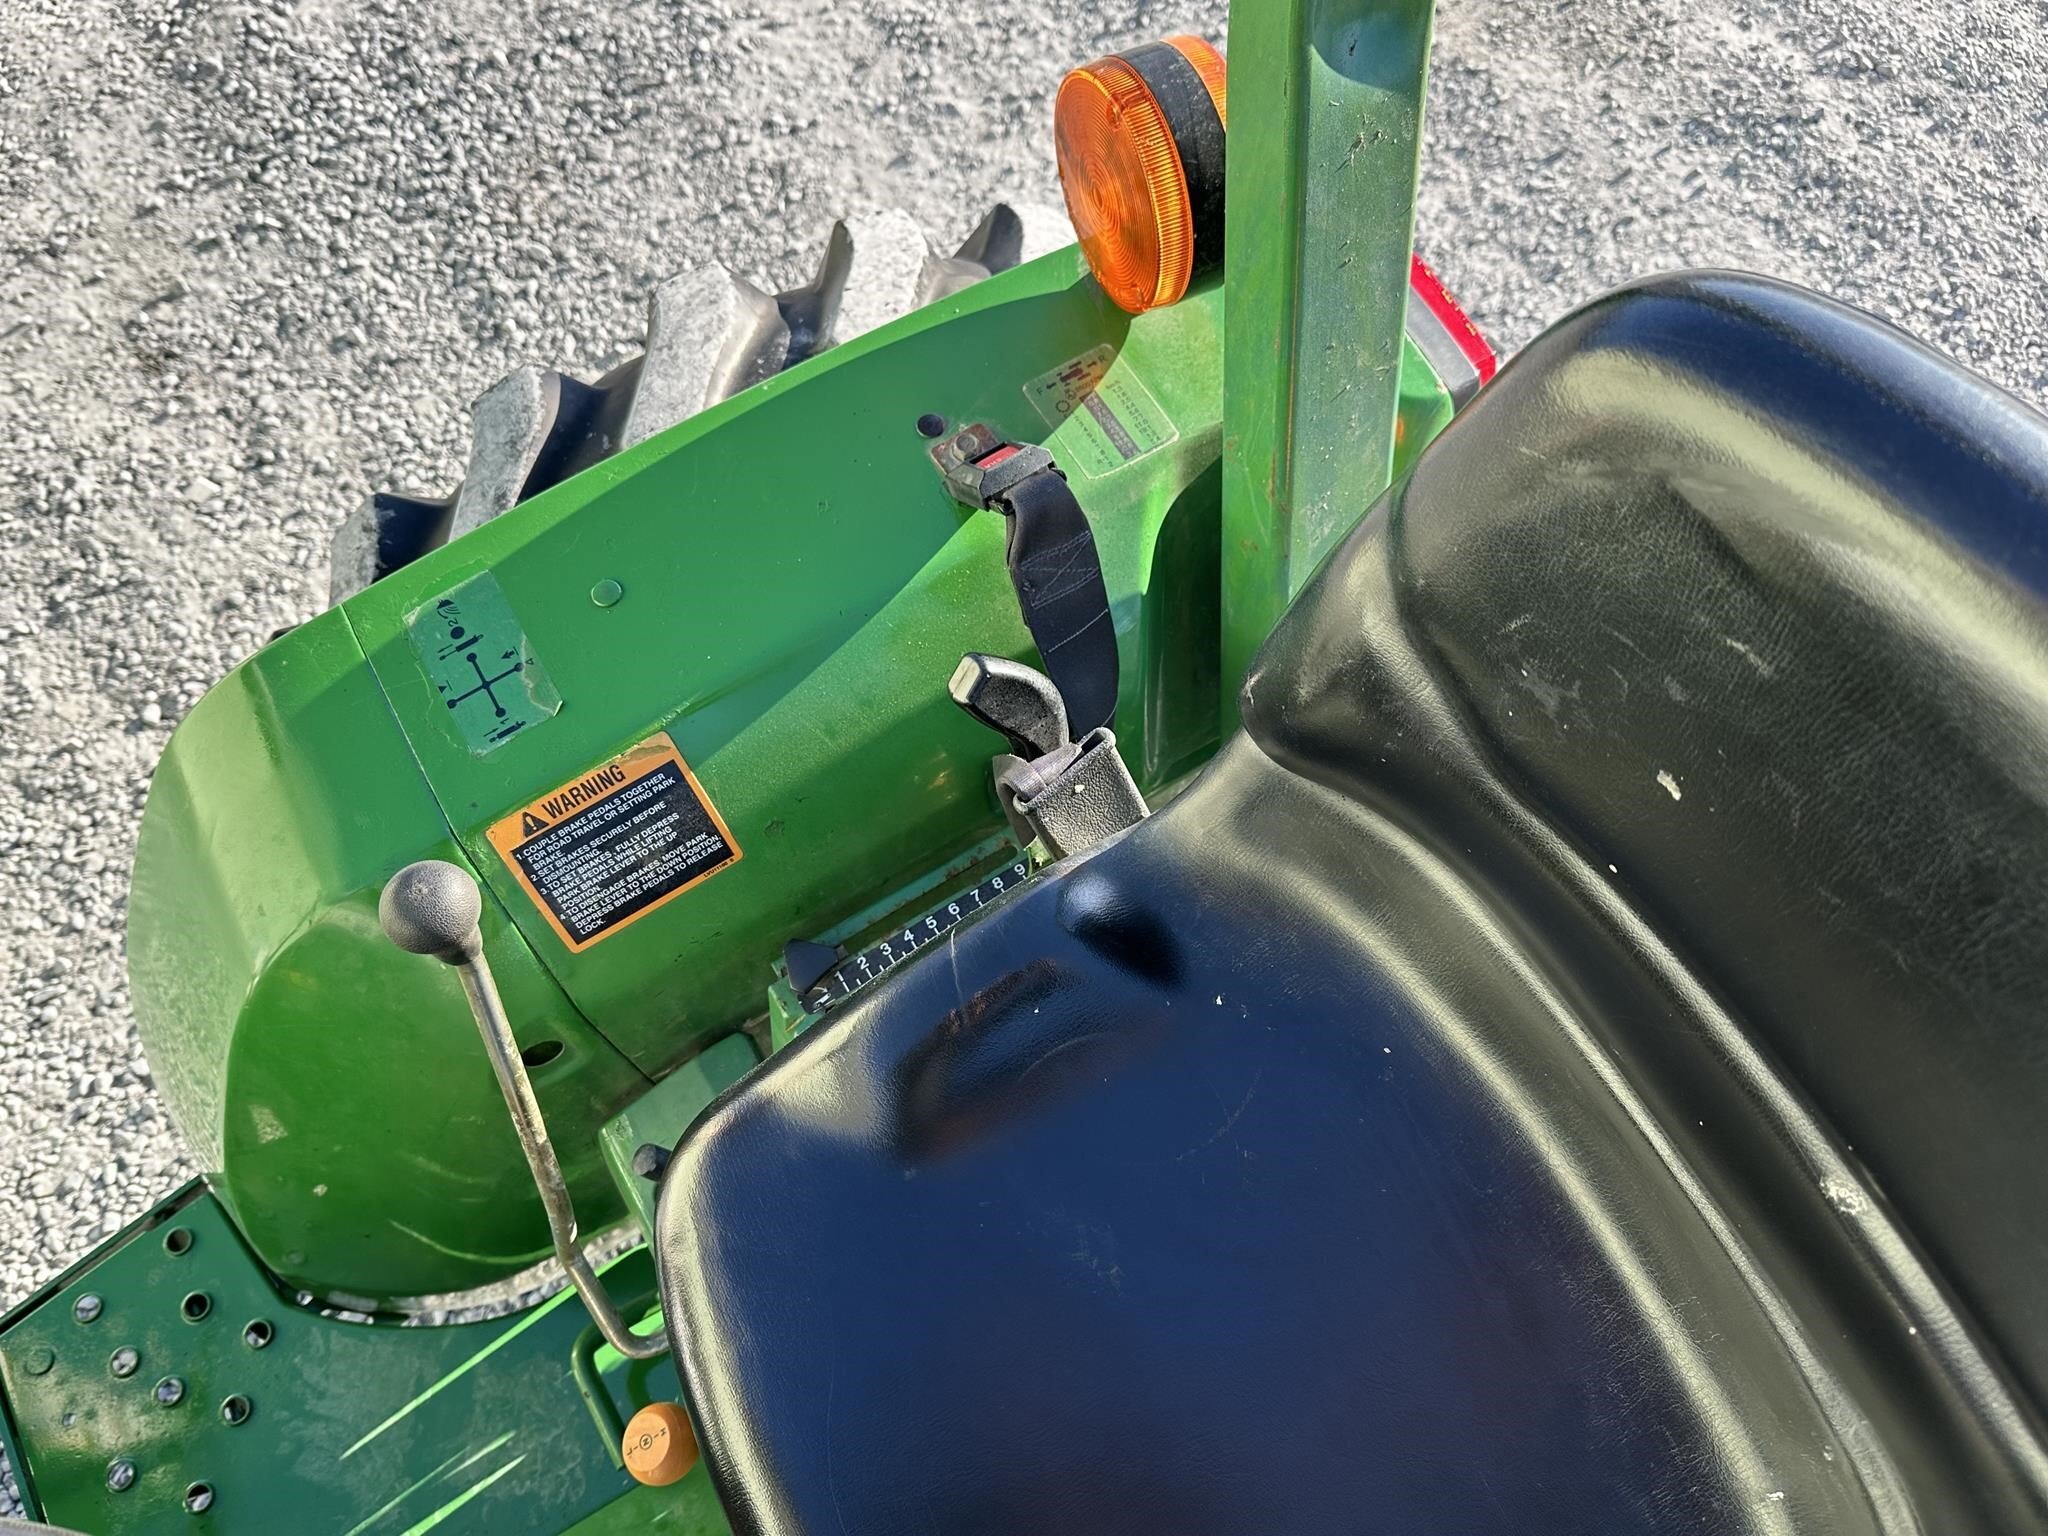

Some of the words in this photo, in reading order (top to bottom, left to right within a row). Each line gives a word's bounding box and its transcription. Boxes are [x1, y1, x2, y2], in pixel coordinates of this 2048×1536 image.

[527, 849, 547, 863] FOR
[546, 834, 572, 853] ROAD
[571, 816, 605, 839] TRAVEL
[603, 809, 618, 821] OR
[616, 789, 653, 813] SETTING
[651, 776, 675, 793] PARK
[540, 763, 626, 820] WARNING
[557, 816, 588, 837] BRAKE
[586, 797, 622, 820] PEDALS
[620, 772, 665, 801] TOGETHER
[532, 848, 565, 870] BRAKE.
[542, 846, 602, 884] DISMOUNTING.
[551, 876, 582, 897] BRAKE
[581, 857, 615, 880] PEDALS
[614, 842, 641, 862] WHILE
[640, 825, 672, 847] LIFTING
[554, 843, 590, 867] BRAKES
[589, 819, 633, 848] SECURELY
[631, 800, 667, 824] BEFORE
[556, 887, 580, 904] PARK
[579, 870, 610, 890] BRAKE
[609, 854, 637, 874] LEVER
[636, 847, 649, 858] TO
[648, 837, 666, 851] THE
[665, 830, 678, 842] UP
[559, 869, 578, 884] SET
[614, 833, 642, 852] FULLY
[640, 811, 680, 838] DEPRESS
[560, 883, 603, 910] POSITION.
[566, 905, 579, 917] TO
[578, 878, 627, 909] DISENGAGE
[661, 844, 686, 862] MOVE
[685, 831, 708, 848] PARK
[570, 902, 601, 923] BRAKE
[599, 887, 628, 906] LEVER
[626, 880, 640, 891] TO
[639, 870, 656, 884] THE
[655, 855, 682, 874] DOWN
[681, 833, 721, 859] POSITION,
[575, 903, 615, 929] DEPRESS
[613, 887, 643, 907] BRAKE
[641, 868, 675, 891] PEDALS
[673, 861, 687, 872] TO
[686, 840, 723, 865] RELEASE
[579, 916, 606, 935] LOCK.
[834, 971, 844, 982] 1
[857, 957, 869, 969] 2
[880, 943, 891, 955] 3
[904, 930, 914, 942] 4
[926, 916, 937, 928] 5
[949, 903, 960, 915] 6
[970, 890, 980, 902] 7
[992, 877, 1003, 889] 8
[1014, 864, 1025, 876] 9
